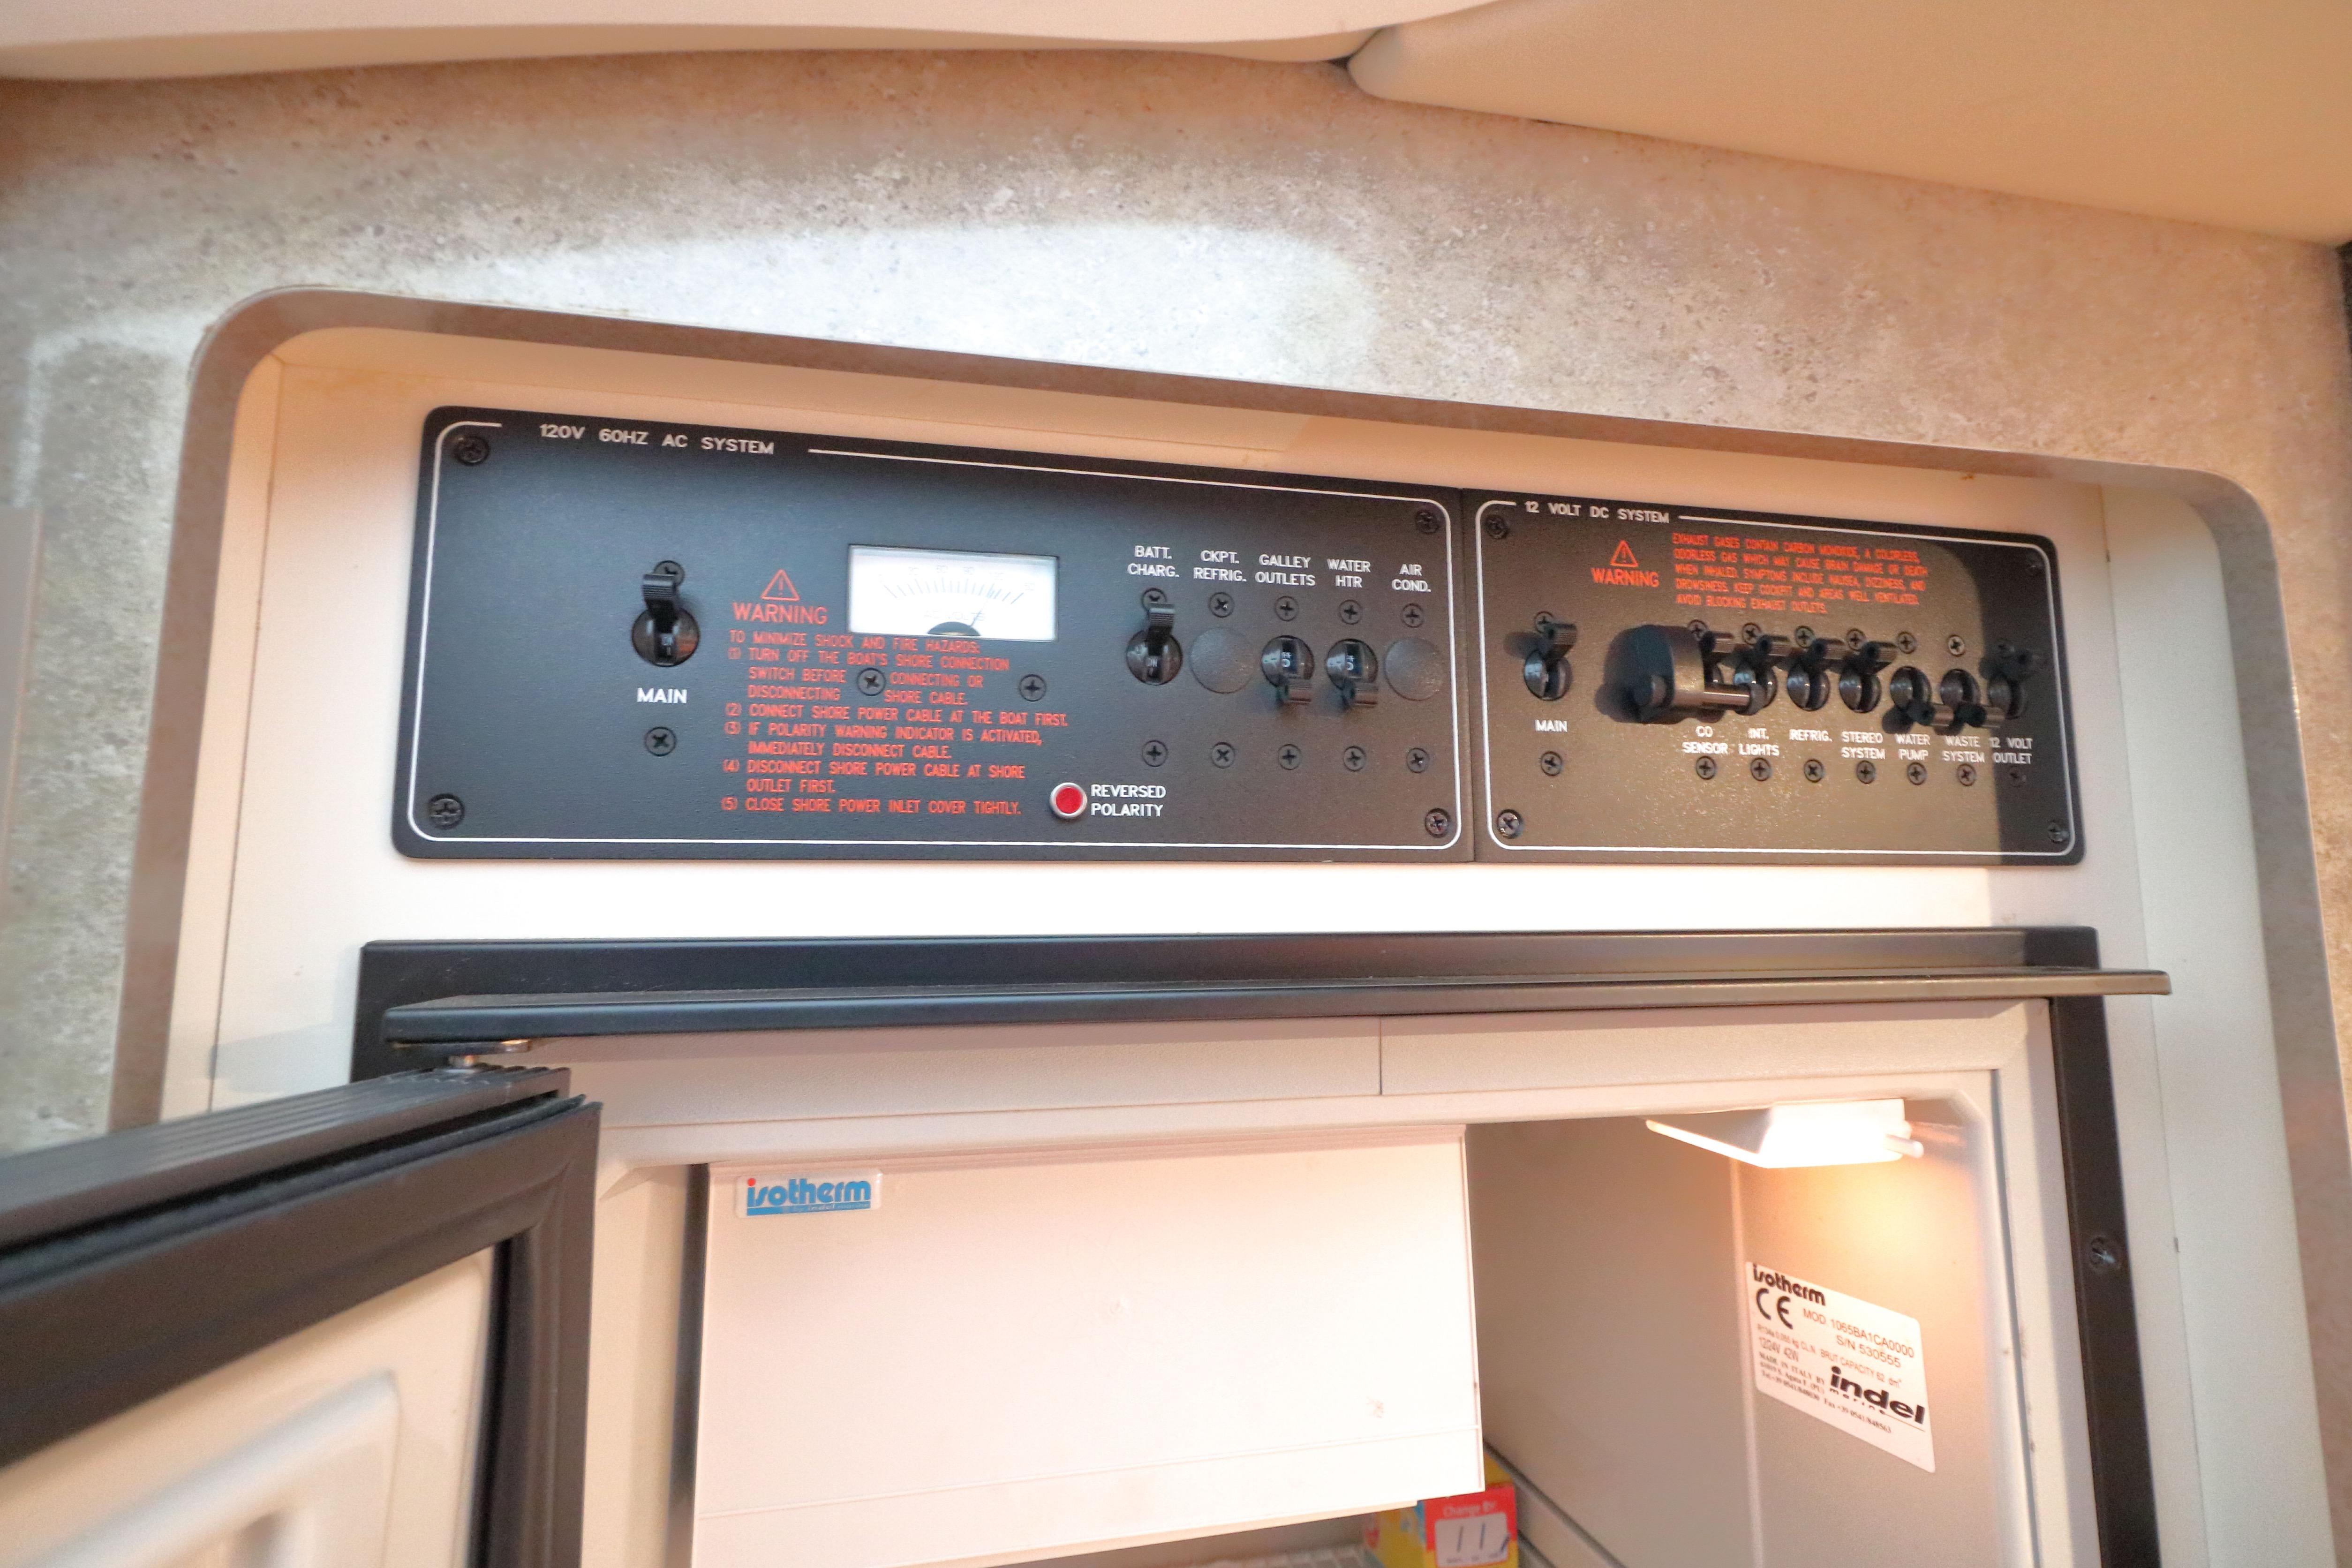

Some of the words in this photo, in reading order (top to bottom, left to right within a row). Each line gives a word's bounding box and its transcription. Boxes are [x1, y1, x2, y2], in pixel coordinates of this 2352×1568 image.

[540, 424, 585, 439] 120V
[599, 429, 648, 445] 60HZ
[662, 434, 687, 447] AC
[701, 437, 774, 454] SYSTEM
[1525, 501, 1539, 513] 12
[1548, 503, 1581, 516] VOLT
[1590, 506, 1609, 519] DC
[1617, 509, 1669, 523] SYSTEM
[1135, 545, 1172, 559] BATT.
[1200, 550, 1239, 563] CKPT.
[1259, 554, 1311, 568] GALLEY
[1327, 559, 1371, 572] WATER
[1127, 563, 1179, 577] CHARG.
[1194, 567, 1246, 581] REFRIG.
[1399, 564, 1422, 576] AIR
[1255, 572, 1315, 586] OUTLETS
[1335, 575, 1362, 588] HTR
[1591, 569, 1659, 587] WARNING
[1392, 579, 1431, 592] COND.
[732, 603, 828, 625] WARNING
[730, 629, 746, 644] TO
[753, 632, 807, 647] MINIMIZE
[814, 634, 853, 648] SHOCK
[861, 636, 885, 649] AND
[893, 637, 918, 651] FIRE
[749, 647, 780, 661] TURN
[787, 649, 810, 662] OFF
[818, 650, 840, 665] THE
[847, 651, 888, 666] BOAT'S
[895, 654, 933, 668] SHORE
[940, 656, 1009, 671] CONNECTION
[749, 666, 795, 681] SWITCH
[802, 668, 846, 683] BEFORE
[890, 672, 960, 687] CONNECTING
[967, 675, 983, 688] OR
[637, 688, 687, 703] MAIN
[748, 685, 840, 701] DISCONNECTING
[884, 690, 921, 704] SHORE
[929, 691, 967, 705] CABLE.
[749, 703, 804, 718] CONNECT
[811, 706, 850, 720] SHORE
[857, 707, 898, 721] POWER
[906, 709, 942, 723] CABLE
[950, 710, 964, 723] AT
[972, 710, 993, 724] THE
[999, 712, 1027, 725] BOAT
[1035, 713, 1068, 726] FIRST.
[748, 722, 761, 735] IF
[768, 723, 826, 737] POLARITY
[835, 725, 887, 739] WARNING
[895, 726, 954, 740] INDICATOR
[962, 729, 974, 741] IS
[1535, 720, 1567, 732] MAIN
[1696, 725, 1713, 737] CO
[1748, 728, 1769, 739] INT.
[1789, 729, 1832, 741] REFRIG.
[1841, 731, 1883, 743] STEREO
[1894, 734, 1930, 745] WATER
[1682, 742, 1728, 754] SENSOR
[1945, 736, 1981, 747] WASTE
[1989, 737, 2001, 748] 12
[2006, 738, 2033, 749] VOLT
[748, 741, 824, 756] IMMEDIATELY
[833, 743, 905, 758] DISCONNECT
[912, 745, 951, 759] CABLE.
[1738, 743, 1779, 756] LIGHTS
[1841, 747, 1885, 759] SYSTEM
[1898, 749, 1928, 760] PUMP
[1942, 751, 1985, 762] SYSTEM
[1991, 752, 2032, 764] OUTLET
[747, 760, 821, 774] DISCONNECT
[829, 761, 867, 776] SHORE
[875, 762, 916, 776] POWER
[924, 763, 960, 777] CABLE
[967, 764, 981, 777] AT
[988, 765, 1025, 779] SHORE
[746, 778, 792, 793] OUTLET
[799, 779, 836, 793] FIRST.
[1091, 784, 1166, 798] REVERSED
[745, 797, 784, 812] CLOSE
[792, 798, 831, 812] SHORE
[839, 799, 880, 813] POWER
[888, 799, 920, 814] INLET
[928, 800, 966, 814] COVER
[973, 801, 1020, 815] TIGHTLY.
[1091, 803, 1163, 816] POLARITY
[746, 1177, 871, 1207] isotherm
[1753, 1263, 1826, 1306] isotherm
[1836, 1335, 1855, 1351] S/N
[1860, 1344, 1901, 1368] 530555
[1841, 1357, 1874, 1377] CAPACITY
[1831, 1366, 1925, 1425] indel
